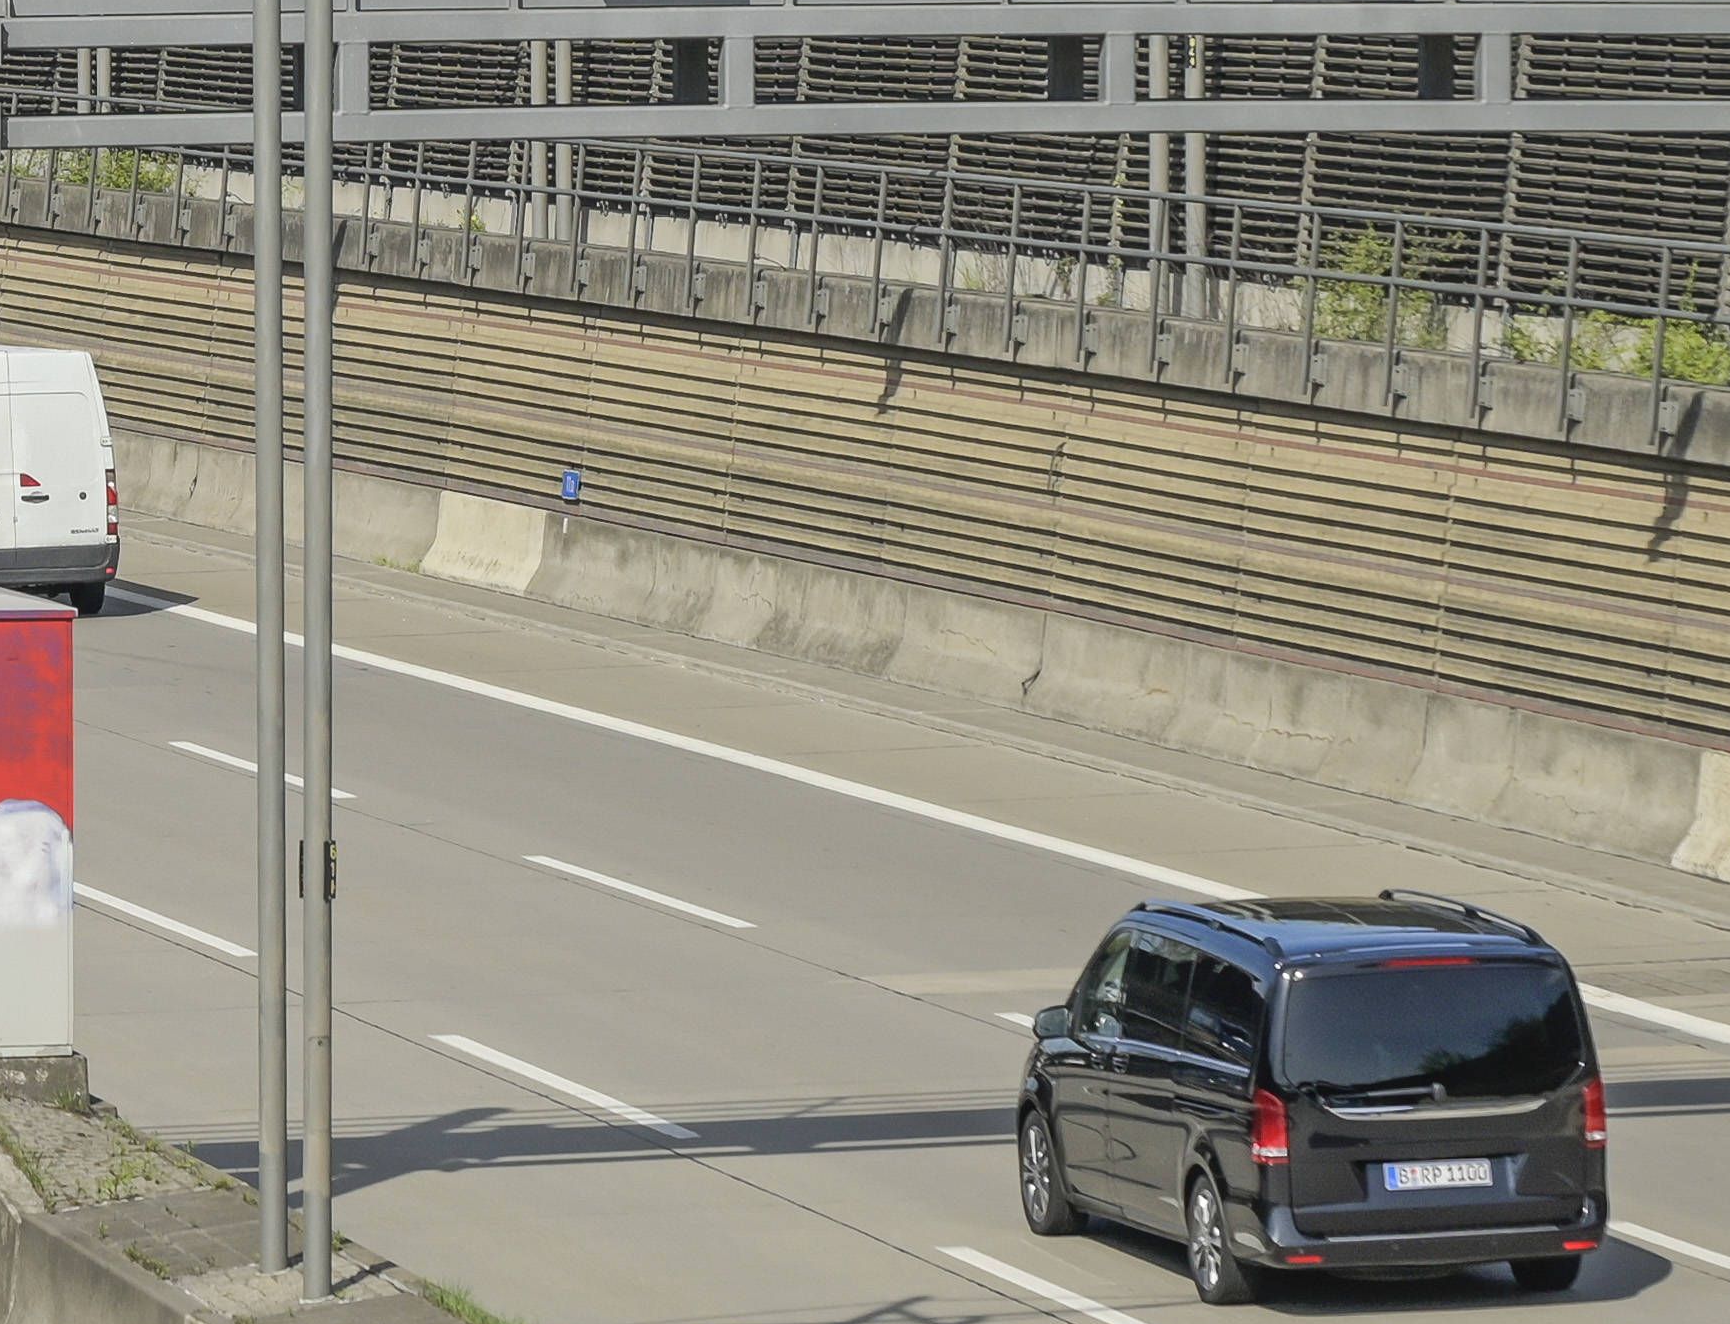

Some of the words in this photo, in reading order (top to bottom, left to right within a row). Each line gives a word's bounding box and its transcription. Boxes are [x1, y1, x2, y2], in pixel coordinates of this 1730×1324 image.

[1399, 1168, 1410, 1185] B
[1421, 1166, 1443, 1184] RP
[1446, 1163, 1488, 1182] 1100
